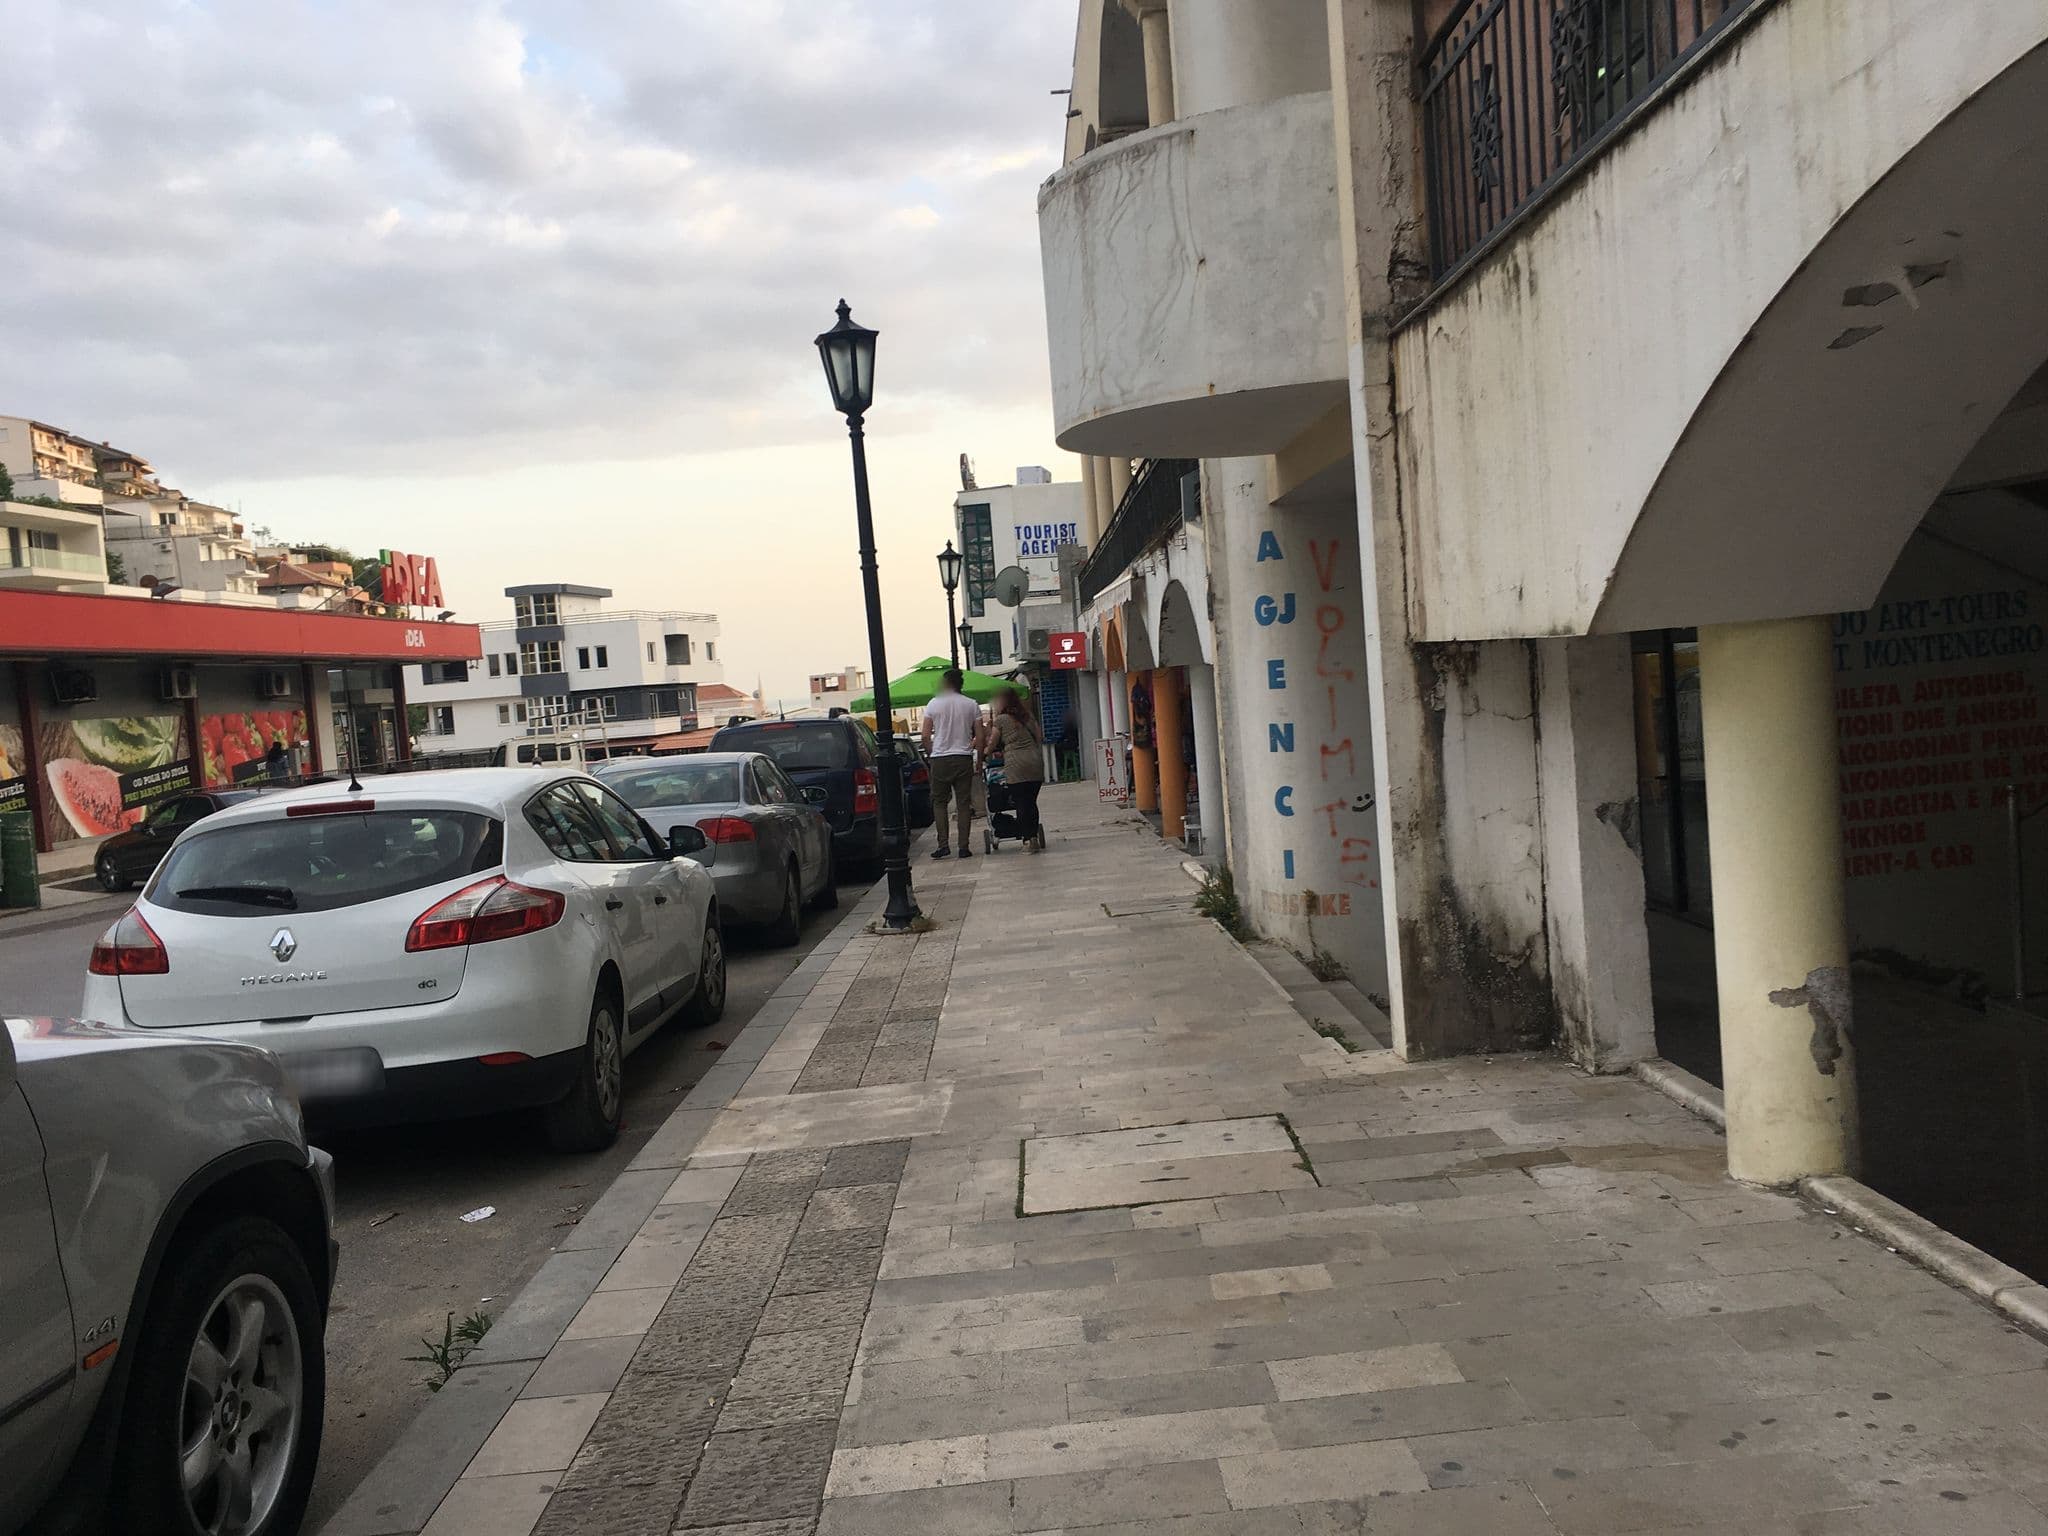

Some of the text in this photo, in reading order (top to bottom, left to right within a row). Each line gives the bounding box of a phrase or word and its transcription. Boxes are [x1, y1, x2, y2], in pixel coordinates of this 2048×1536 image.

[1014, 522, 1077, 540] TOURIST
[1879, 589, 2028, 633] ART-TOURS
[1864, 623, 2045, 670] MONTENEGRO
[1255, 530, 1296, 880] AGJENCI
[1105, 738, 1116, 786] INDIA
[1099, 787, 1126, 797] SHOP
[1930, 844, 1975, 870] CAR
[240, 970, 328, 986] MEGANE
[417, 978, 437, 990] dCi
